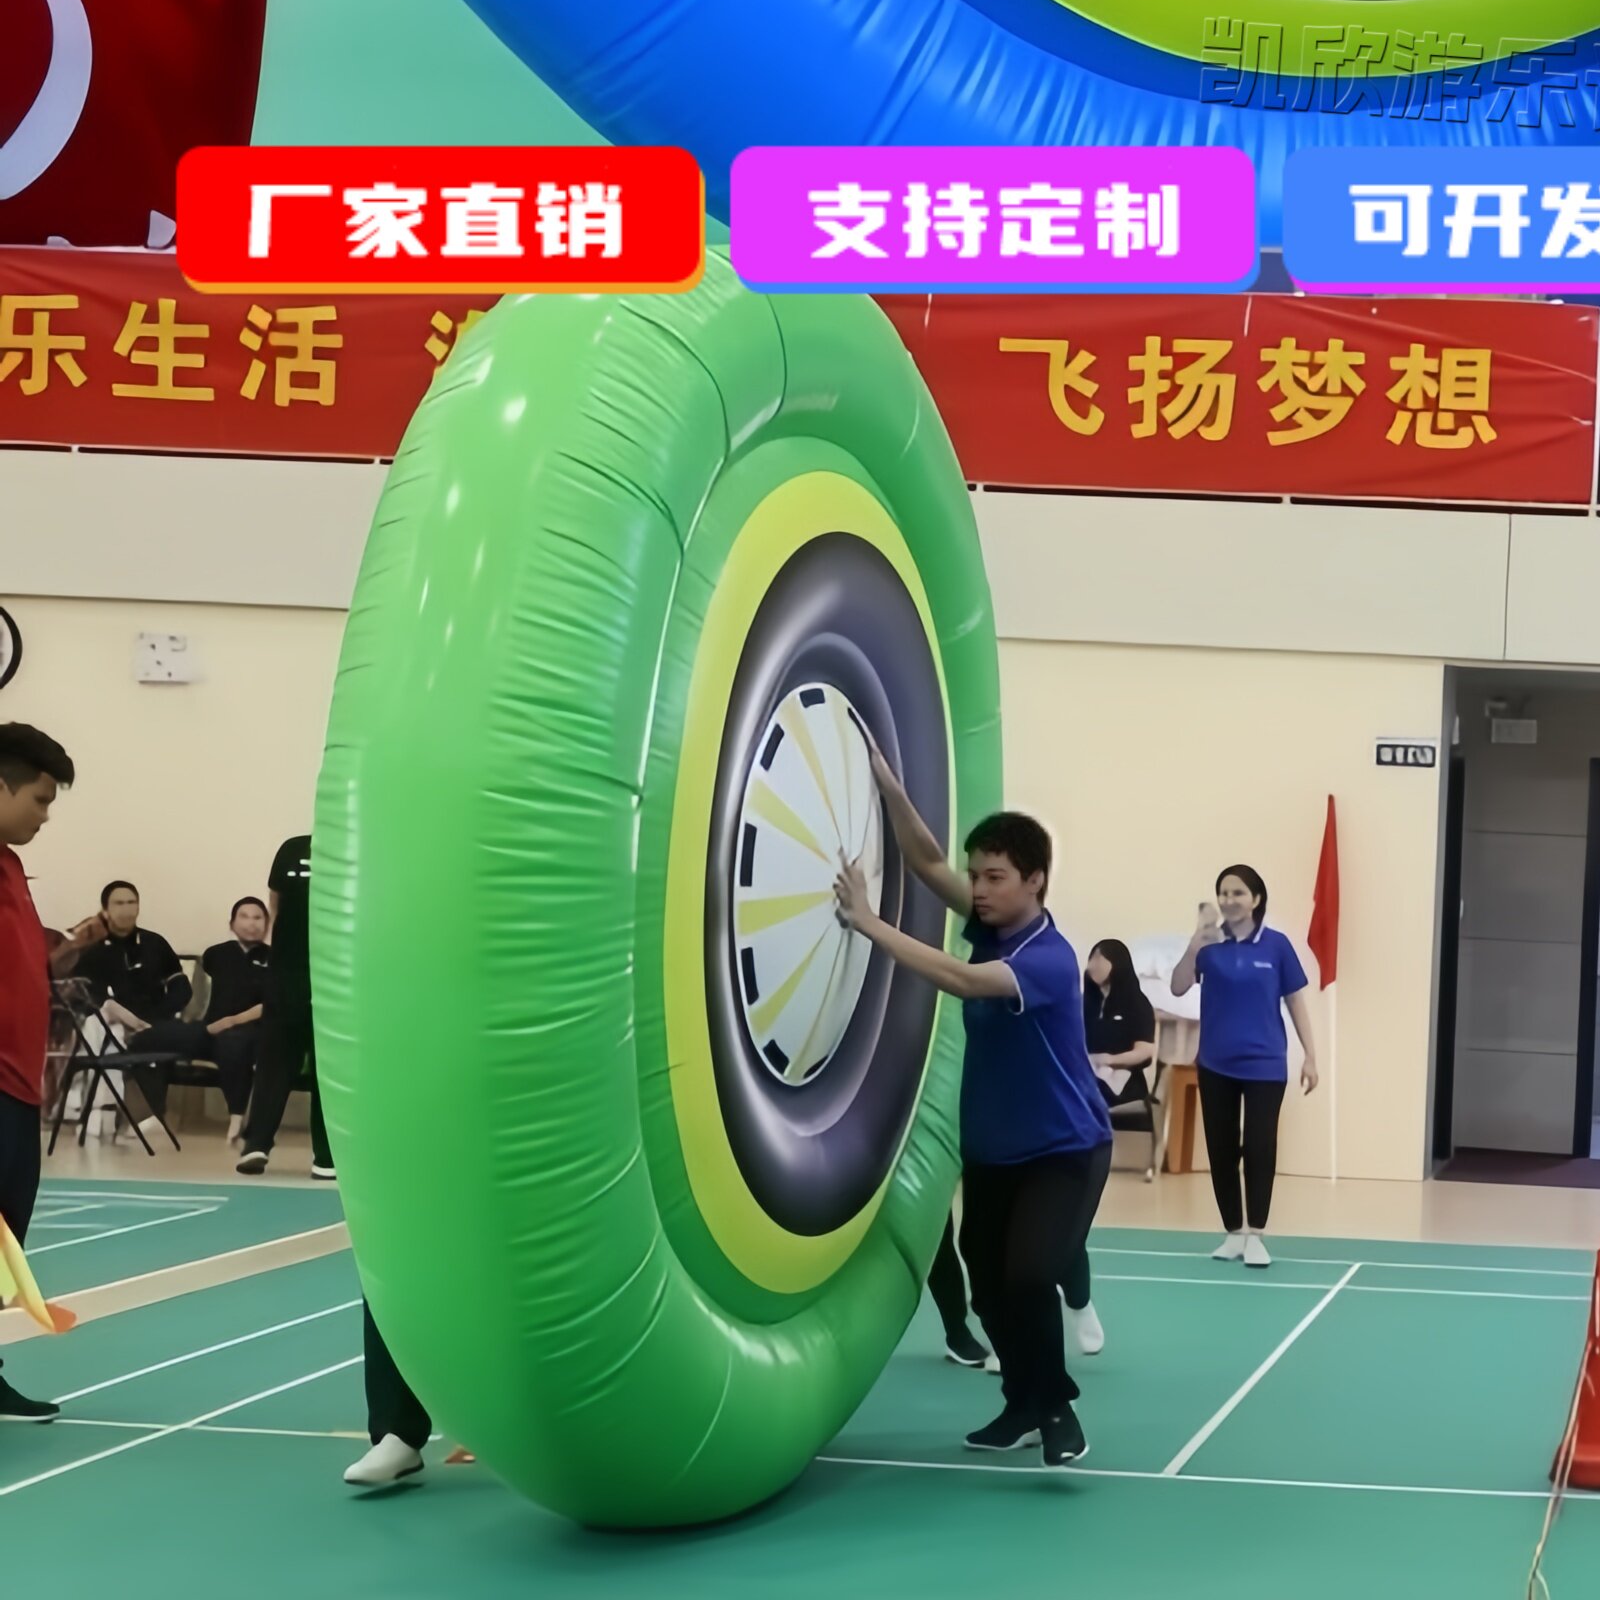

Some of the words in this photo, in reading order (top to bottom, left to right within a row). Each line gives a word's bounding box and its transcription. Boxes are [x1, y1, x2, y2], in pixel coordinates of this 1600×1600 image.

[0, 293, 344, 407] 乐生活
[998, 335, 1498, 450] 飞扬梦想
